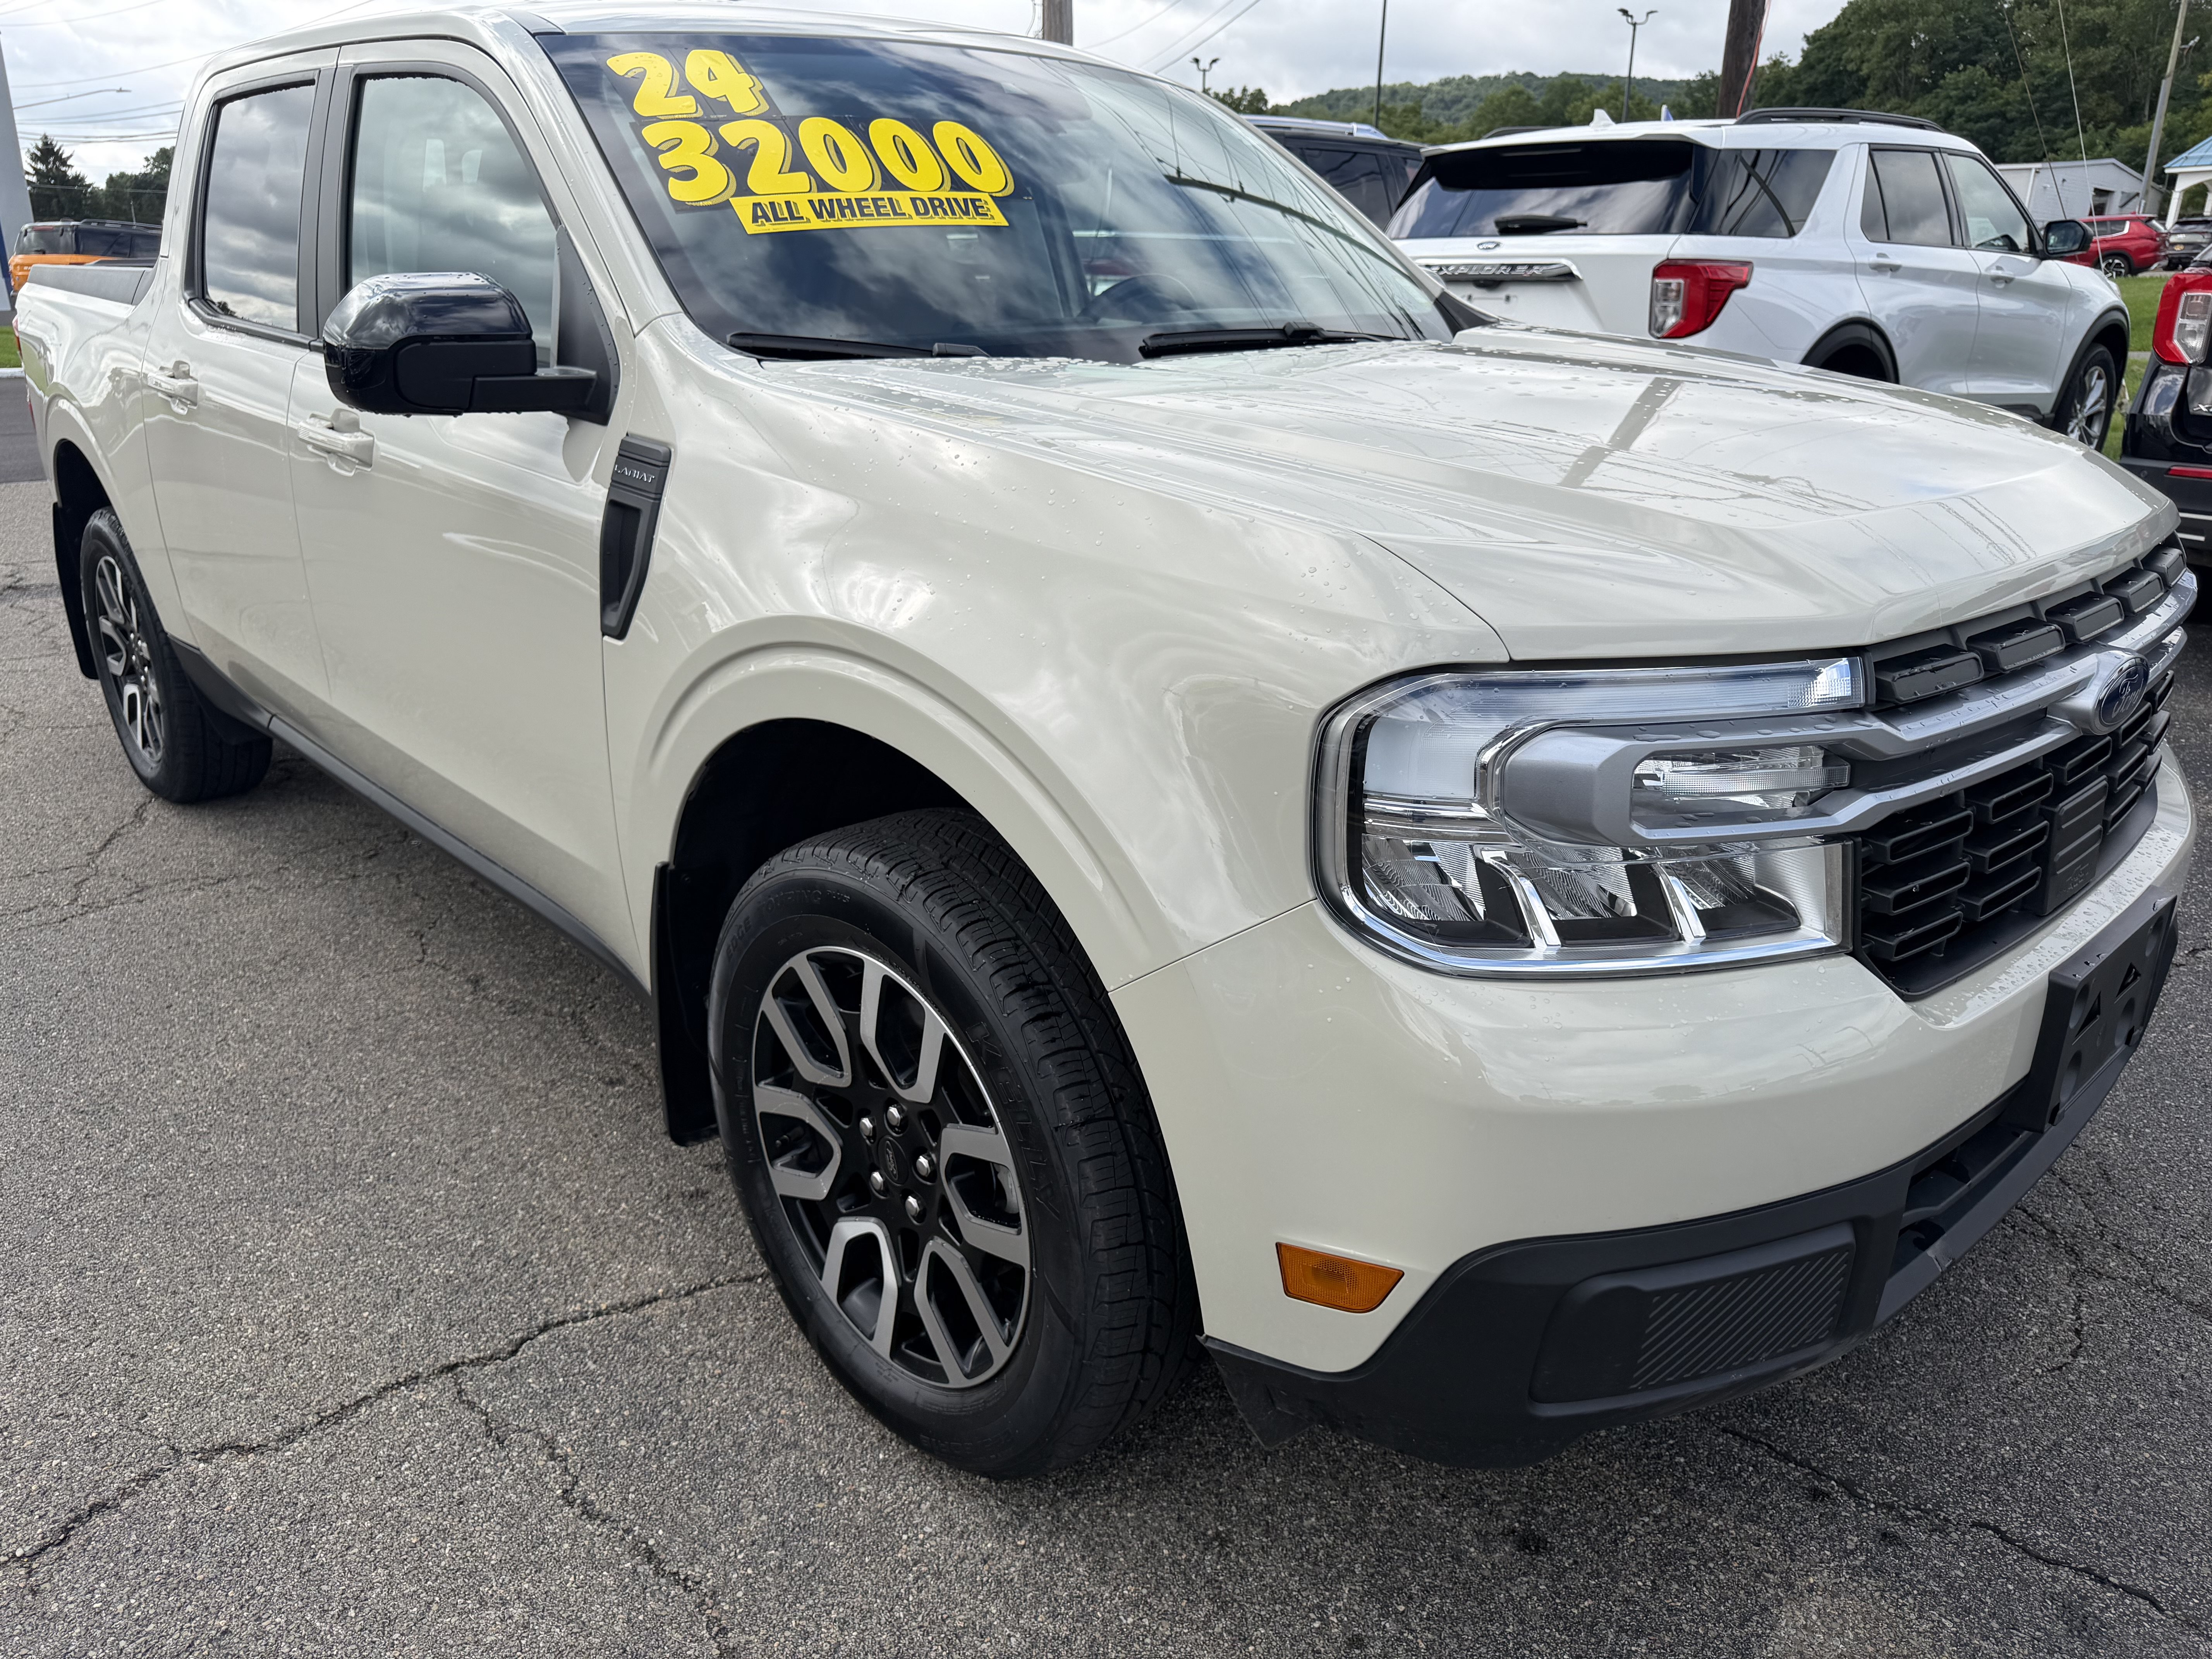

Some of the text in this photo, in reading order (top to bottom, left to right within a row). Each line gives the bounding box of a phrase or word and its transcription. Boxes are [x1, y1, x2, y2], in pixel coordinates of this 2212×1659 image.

[606, 50, 769, 120] 24
[642, 117, 1014, 205] 32000
[752, 197, 994, 227] ALL WHEEL DRIVE
[1431, 265, 1544, 275] EXPLORER
[614, 464, 655, 483] LARIAT
[2111, 673, 2144, 718] Ford
[726, 915, 752, 963] EDGE
[965, 1021, 1061, 1222] KELLY
